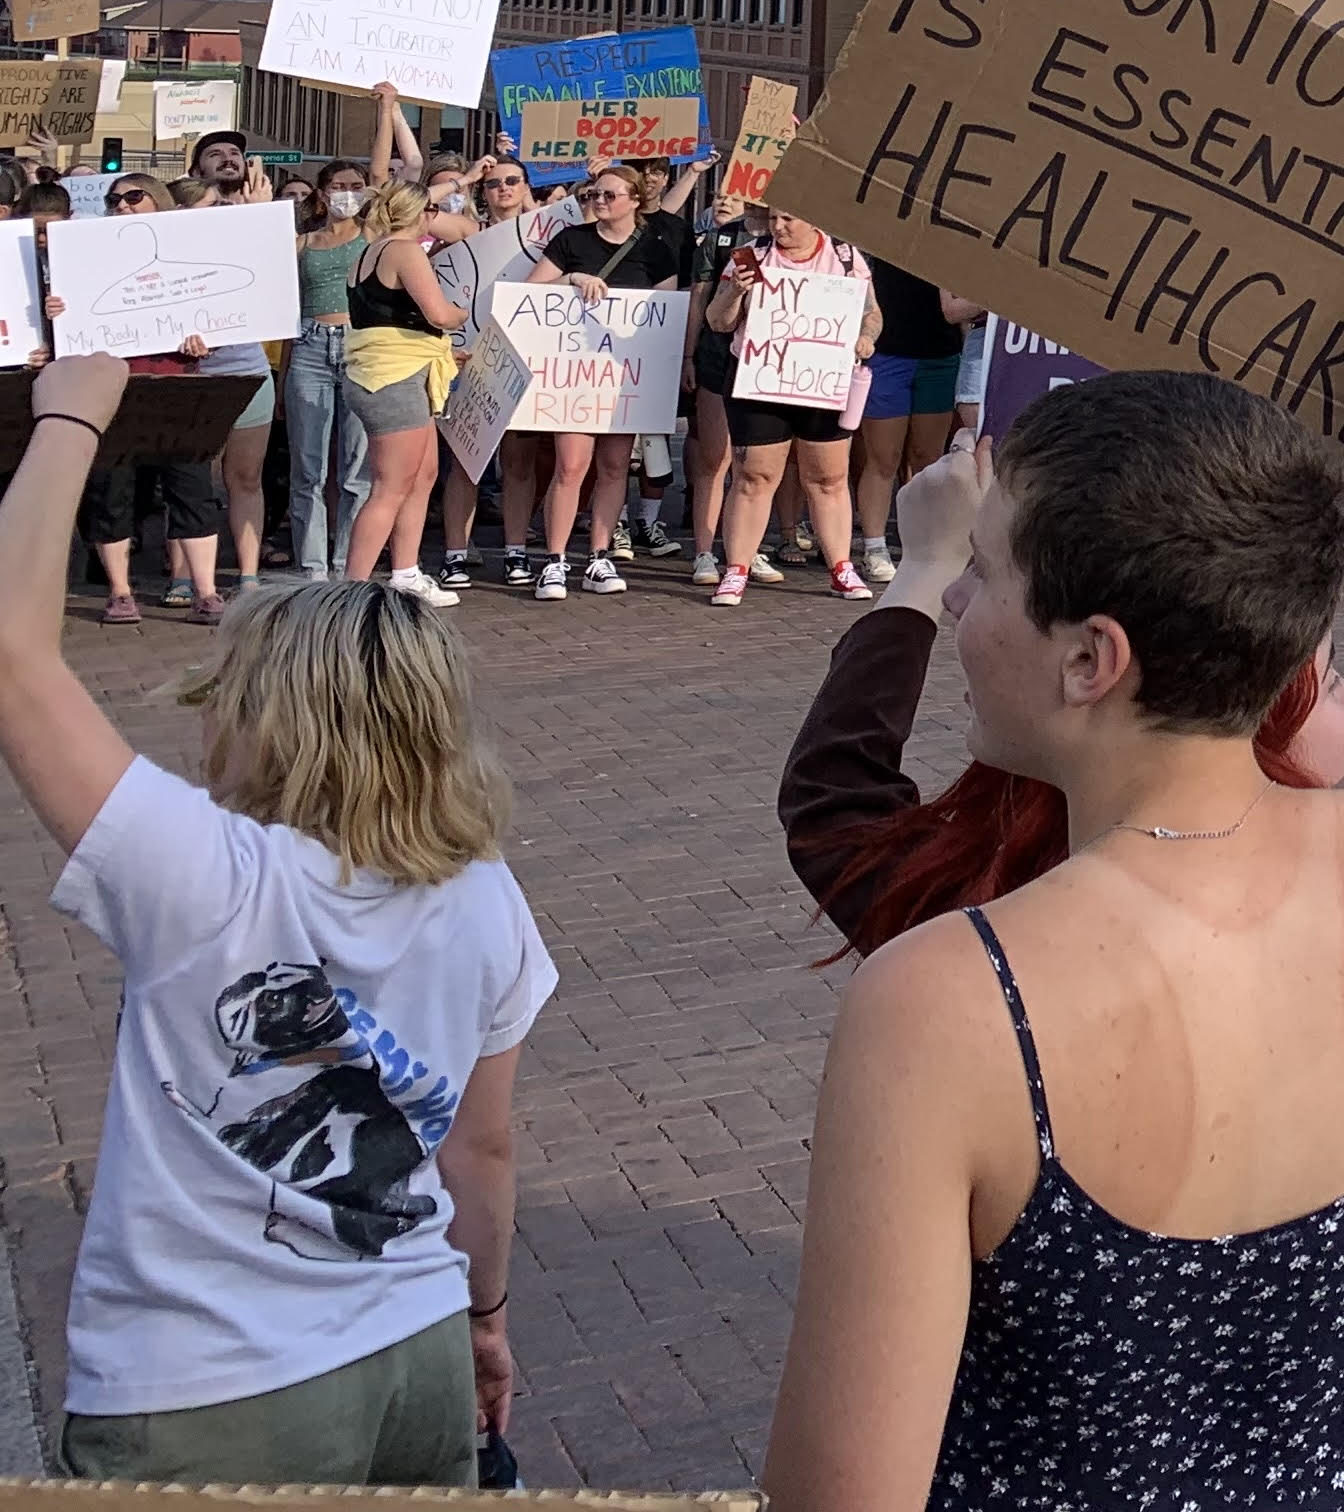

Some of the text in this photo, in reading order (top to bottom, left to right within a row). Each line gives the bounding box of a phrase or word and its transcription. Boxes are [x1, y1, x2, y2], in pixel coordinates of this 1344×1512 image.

[286, 10, 327, 38] AN
[0, 68, 89, 83] PRODUCTIVE
[285, 42, 454, 90] I AM A WOMAN
[534, 40, 657, 81] RESPECT
[59, 88, 86, 104] ARE
[761, 79, 784, 97] MY
[0, 111, 43, 135] UMAN
[581, 100, 638, 117] HER
[576, 116, 661, 139] BODY
[287, 153, 298, 163] St
[531, 136, 698, 158] HER CHOICE
[726, 160, 778, 200] NO
[507, 293, 667, 328] ABORTION
[758, 277, 809, 314] MY
[65, 331, 95, 356] My
[156, 314, 184, 341] My
[193, 308, 248, 333] Choice
[558, 331, 613, 353] IS A
[770, 309, 847, 343] BODY
[744, 338, 790, 375] MY
[527, 357, 642, 389] HUMAN
[754, 360, 849, 397] CHOICE
[533, 392, 641, 426] RIGHT
